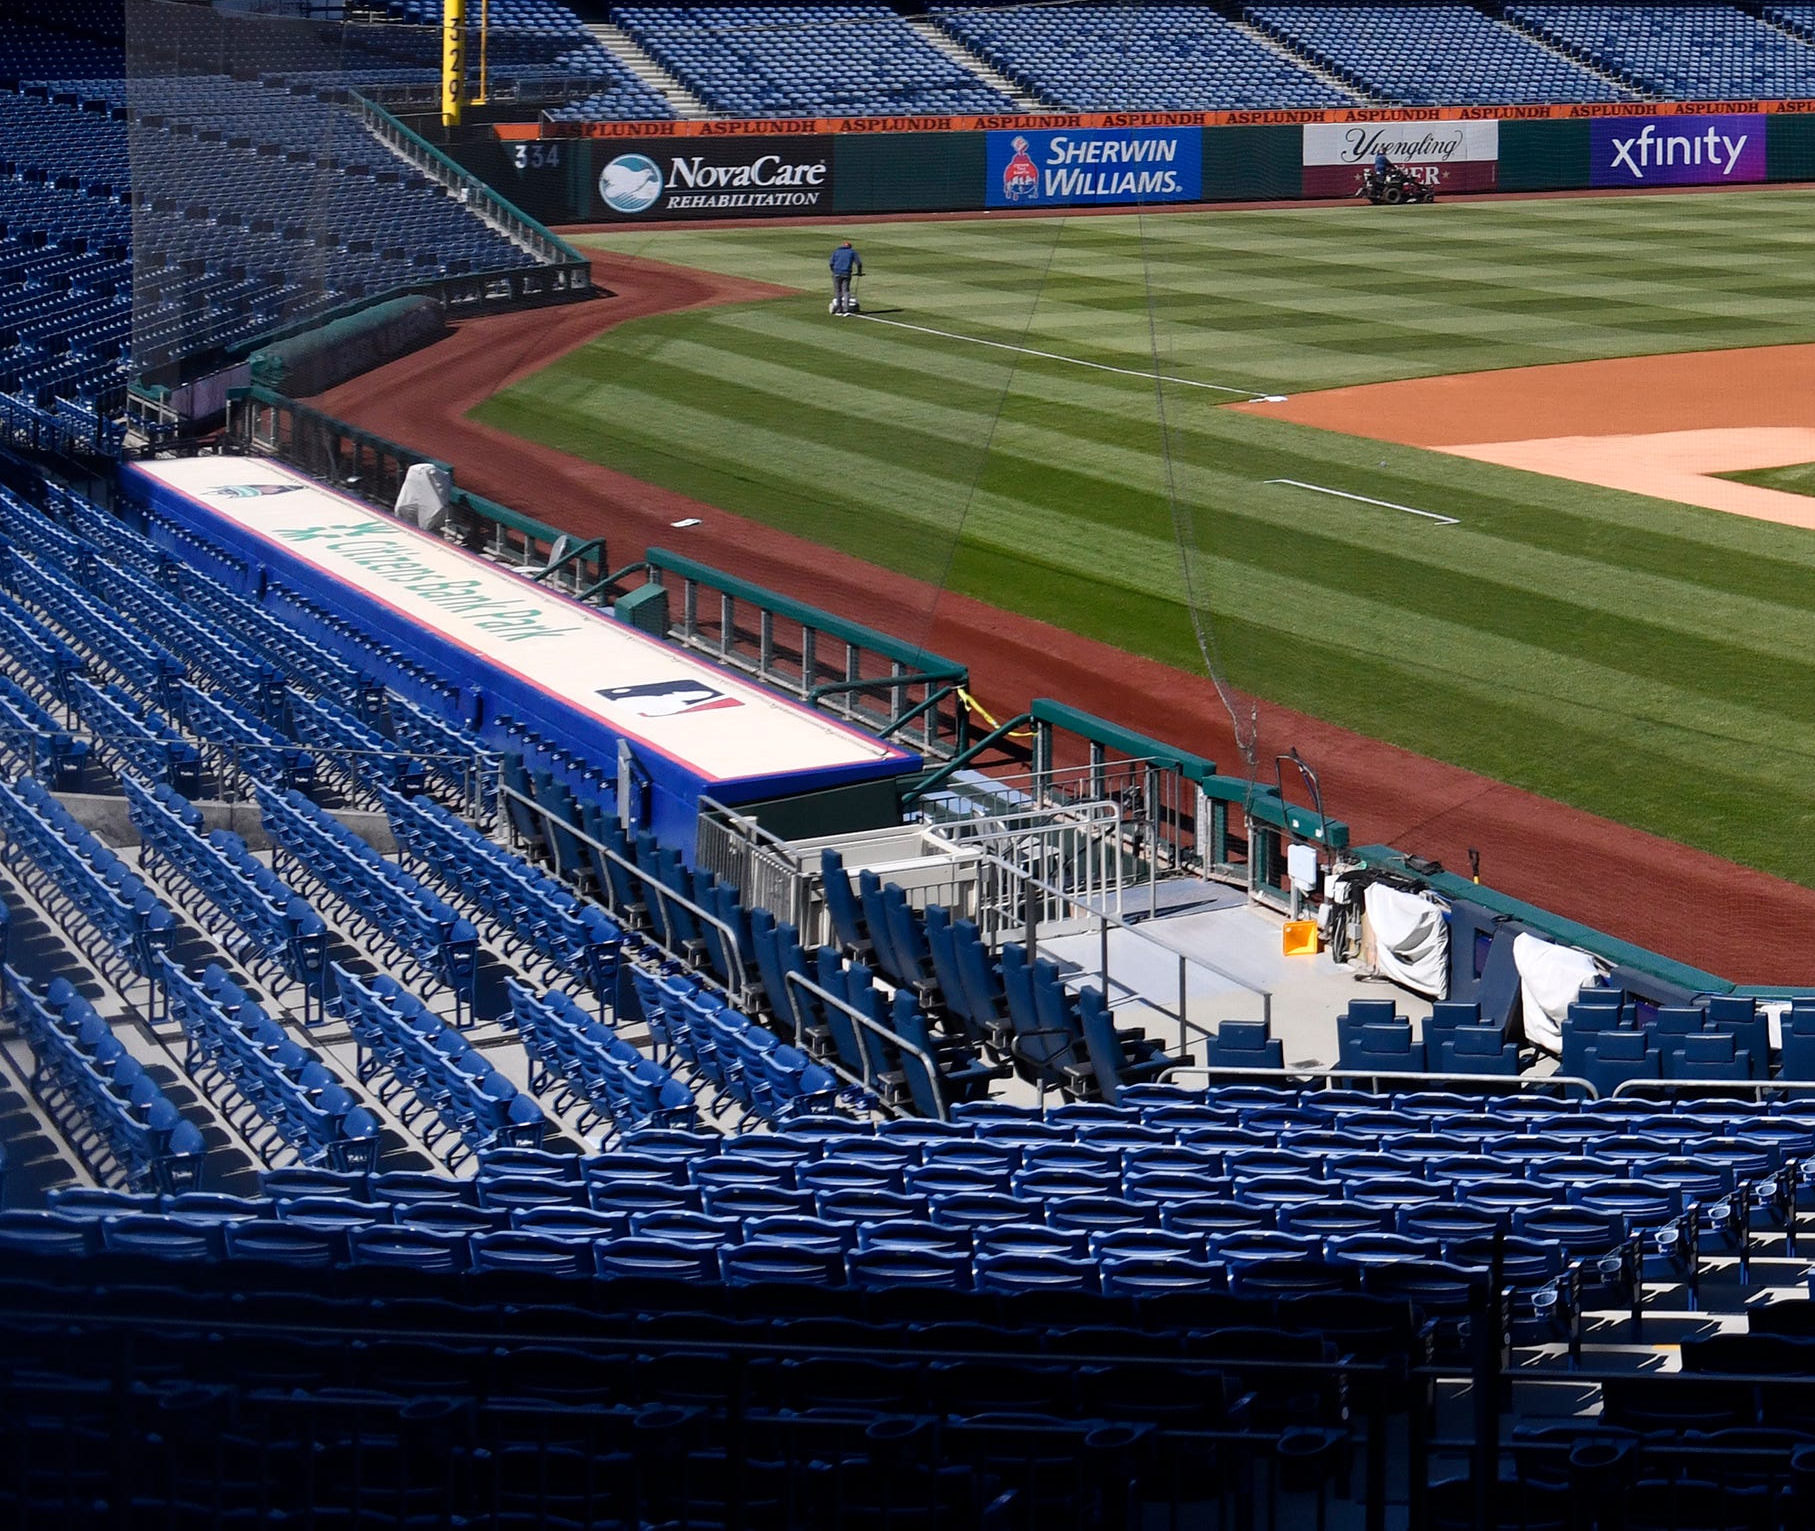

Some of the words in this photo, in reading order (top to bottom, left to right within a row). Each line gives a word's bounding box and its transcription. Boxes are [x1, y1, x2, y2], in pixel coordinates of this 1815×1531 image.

[513, 141, 561, 169] 334
[1047, 137, 1177, 165] SHERWIN
[1341, 127, 1463, 163] Yuengling
[1611, 124, 1747, 178] xfinity
[664, 156, 826, 188] NovaCare
[666, 192, 820, 210] REHABILITATION
[326, 540, 446, 583] Citizens
[404, 579, 526, 619] Bank
[474, 608, 583, 642] Park
